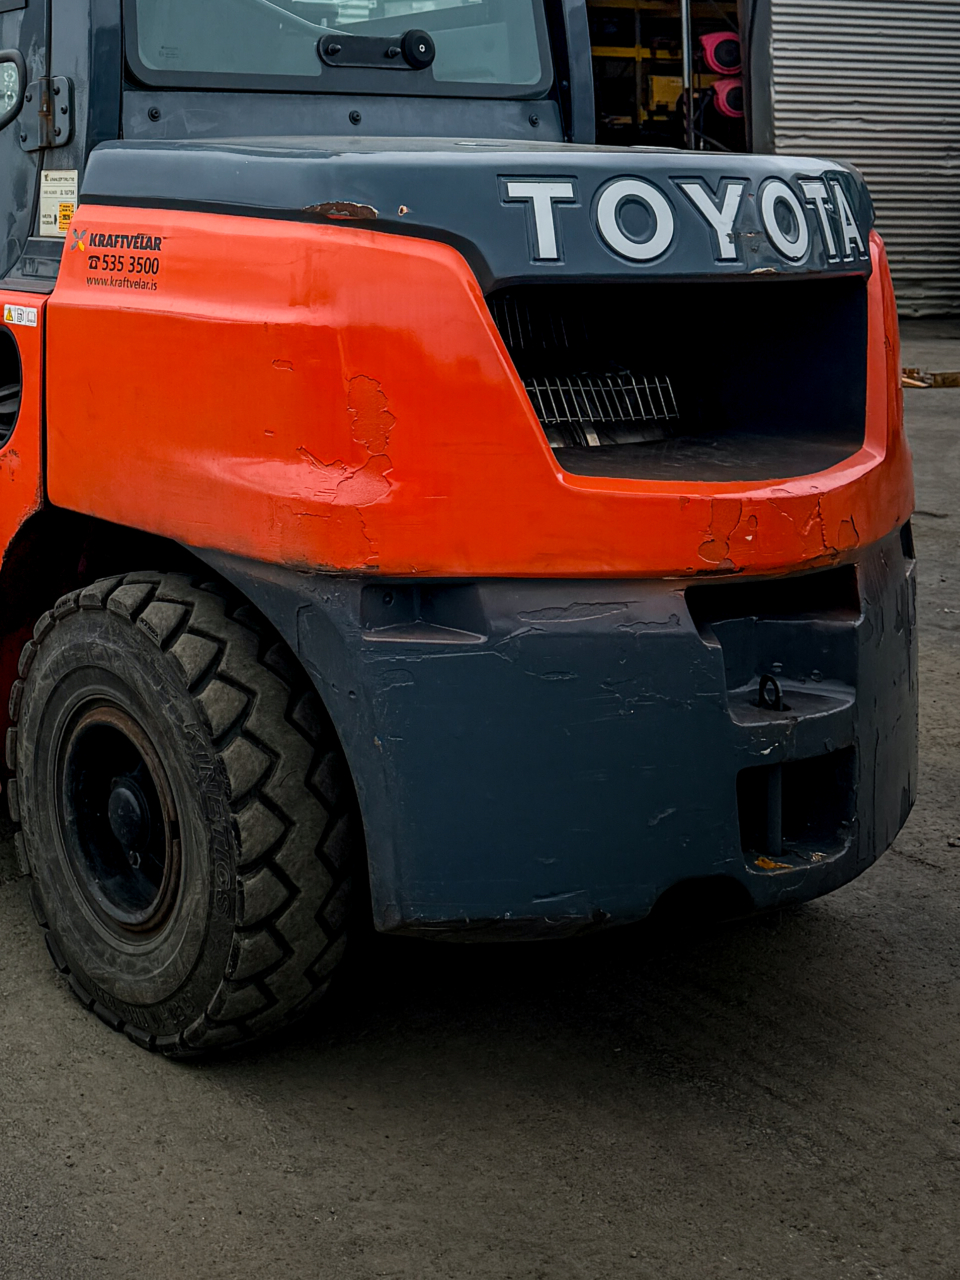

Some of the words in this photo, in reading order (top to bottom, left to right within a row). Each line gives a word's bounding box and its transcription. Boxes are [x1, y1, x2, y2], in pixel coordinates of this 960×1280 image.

[507, 180, 866, 262] TOYOTA
[89, 233, 162, 251] KRAFTVÉLAR
[101, 254, 125, 272] 535
[127, 256, 160, 275] 3500
[86, 276, 158, 291] www.kraftvelar.is
[184, 721, 233, 920] KINETICS
